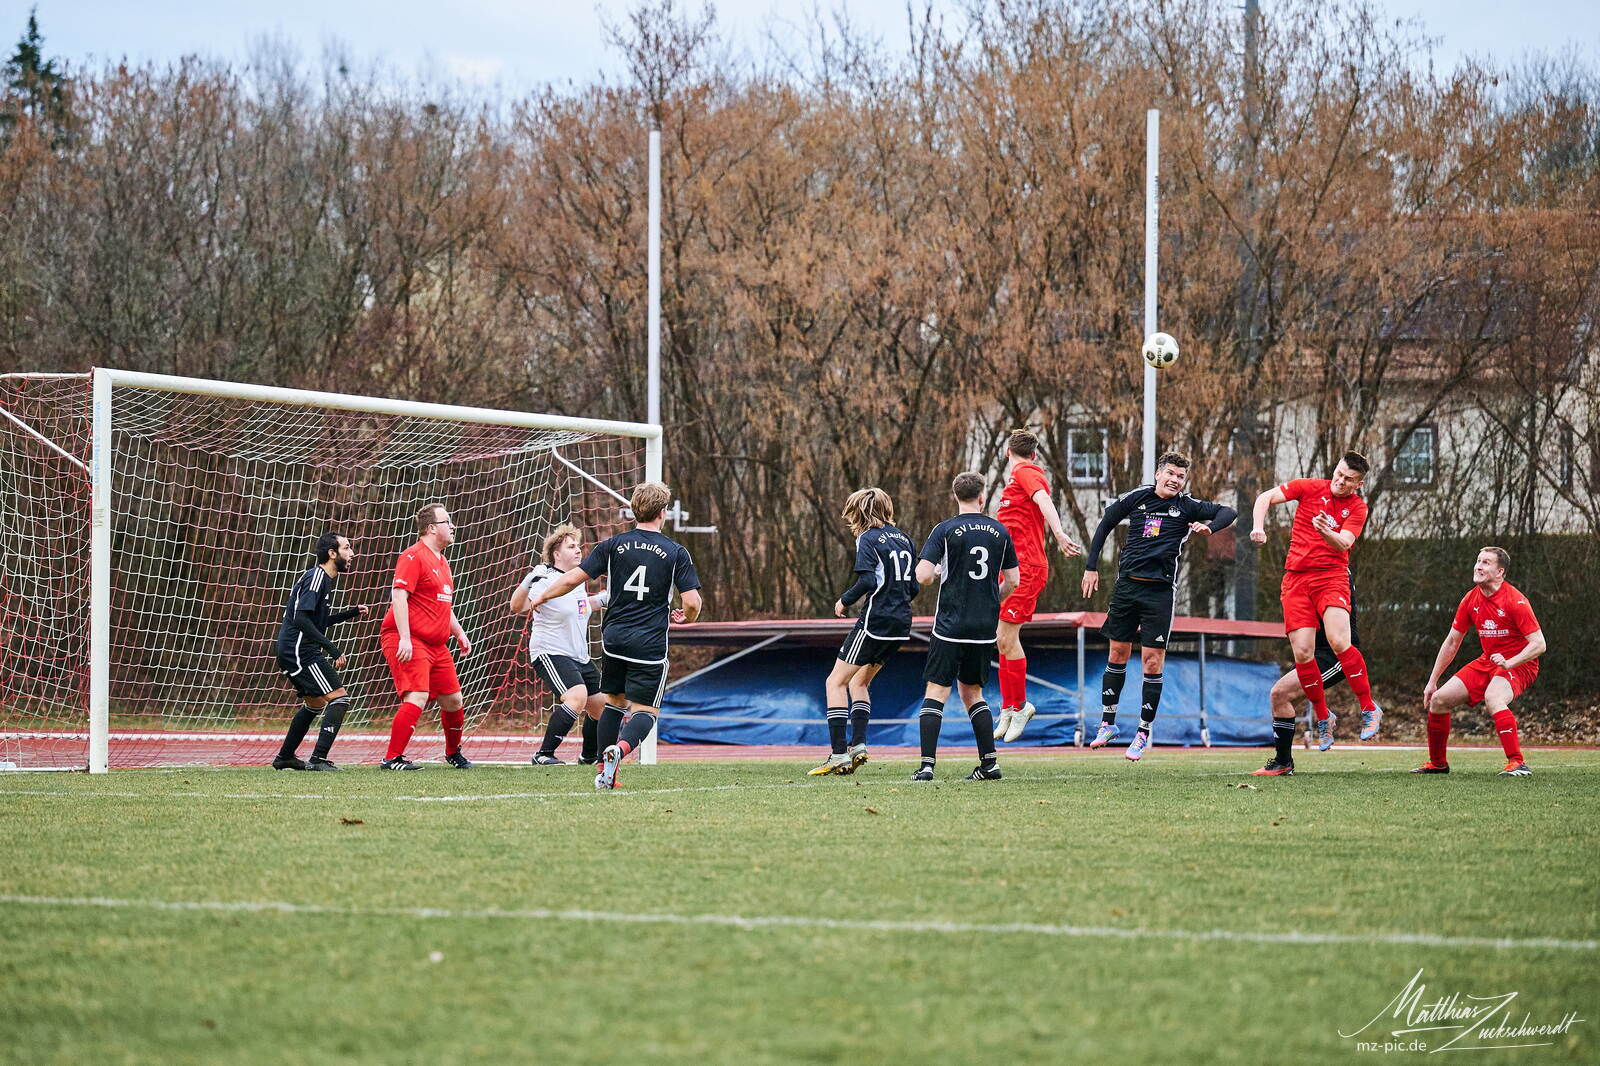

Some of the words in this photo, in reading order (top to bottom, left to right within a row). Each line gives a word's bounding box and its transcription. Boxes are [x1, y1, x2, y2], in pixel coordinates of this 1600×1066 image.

[878, 533, 888, 544] SV
[954, 524, 967, 537] SV
[968, 523, 1000, 538] Laufen
[617, 542, 631, 554] SV
[634, 541, 668, 559] Laufen
[889, 550, 912, 581] 12
[968, 546, 989, 580] 3
[623, 565, 650, 601] 4
